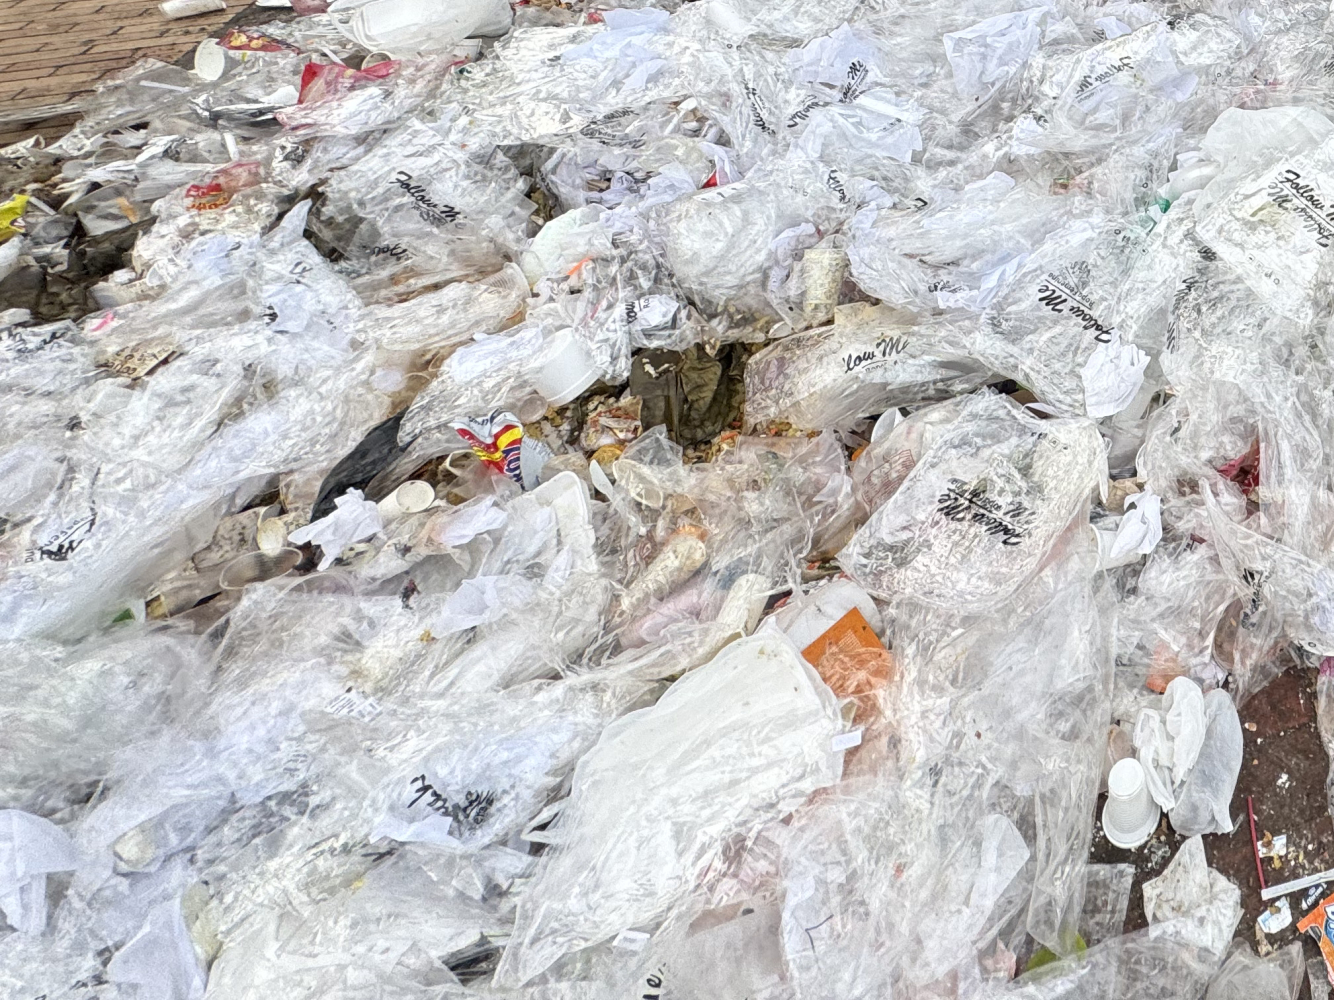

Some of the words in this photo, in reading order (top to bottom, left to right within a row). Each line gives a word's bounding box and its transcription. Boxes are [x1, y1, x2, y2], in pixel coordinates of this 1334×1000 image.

[389, 170, 438, 209] Follow
[1279, 168, 1325, 211] Follow
[1037, 283, 1068, 314] Me
[938, 492, 971, 522] Me
[973, 510, 1023, 546] Follow
